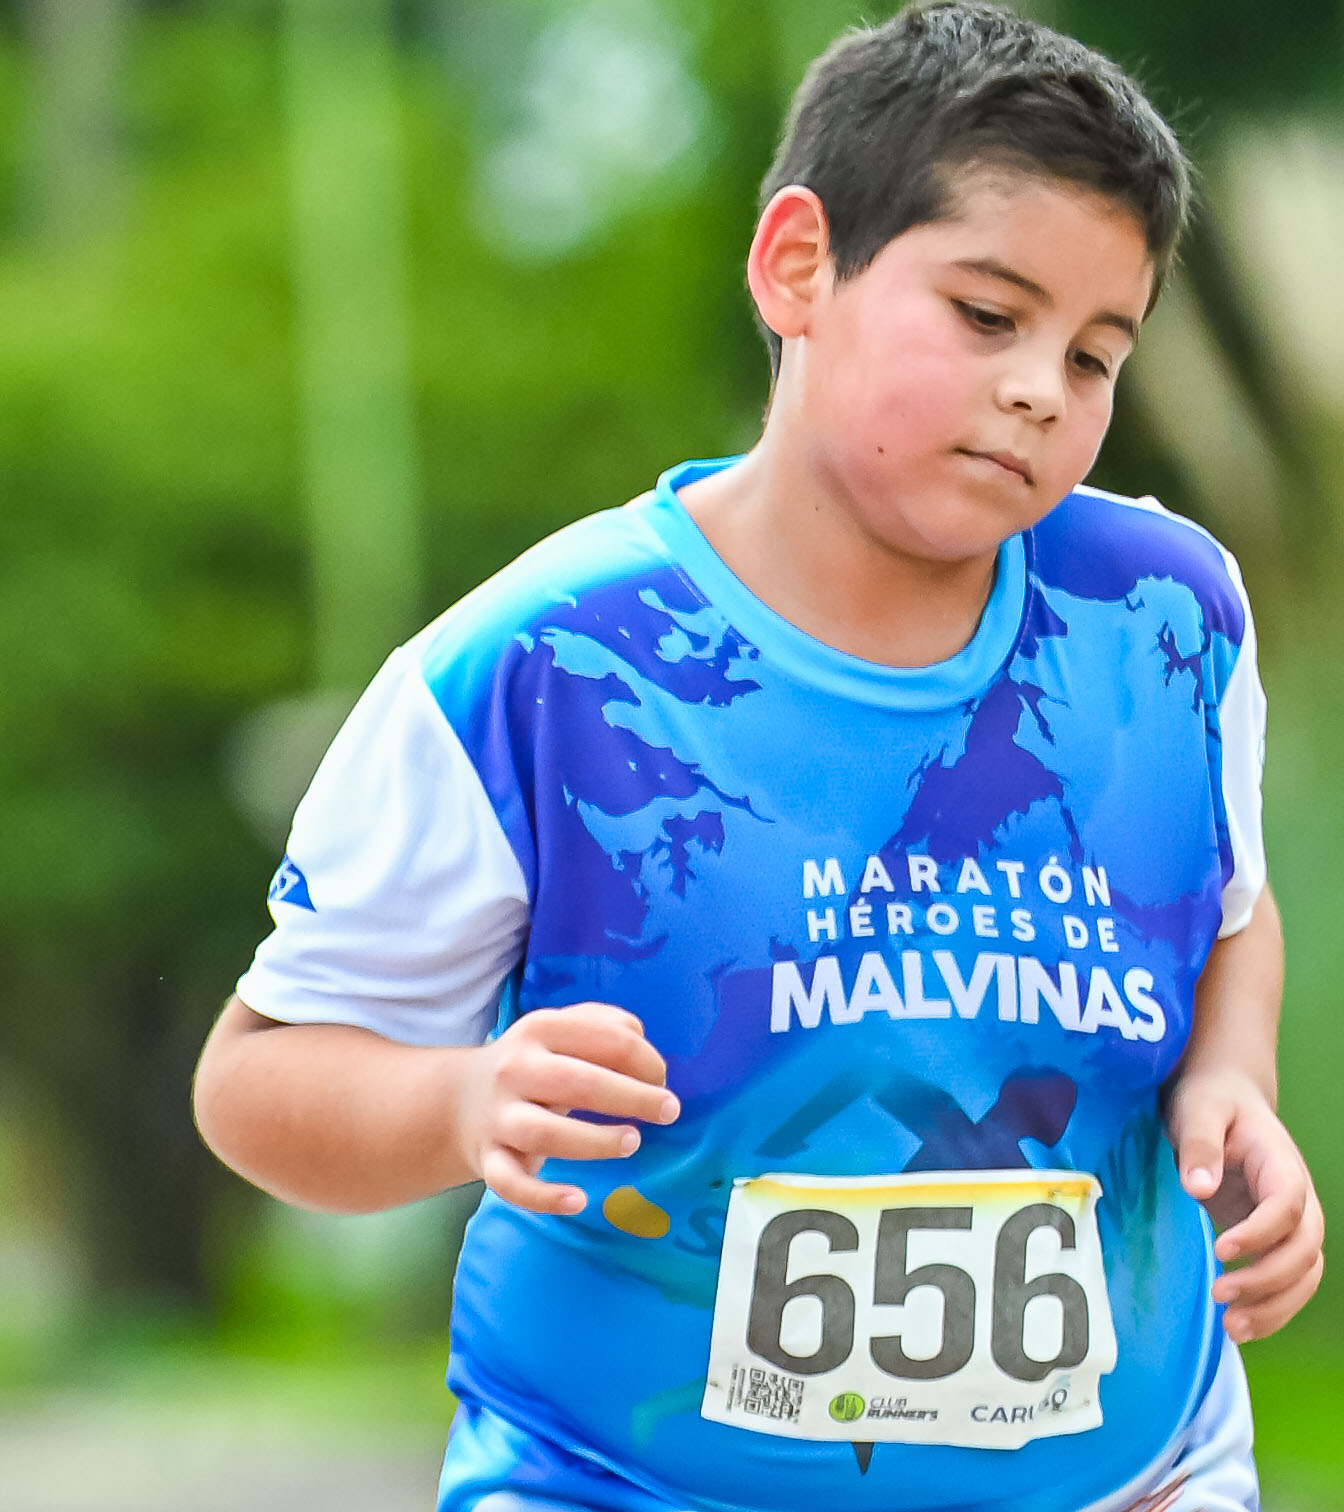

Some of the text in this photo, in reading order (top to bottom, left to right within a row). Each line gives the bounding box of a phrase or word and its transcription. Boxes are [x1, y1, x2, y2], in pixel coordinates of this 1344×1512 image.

[802, 854, 1112, 907] MARATÓN
[806, 896, 1120, 953] HÉROES DE
[770, 950, 1167, 1043] MALVINAS
[746, 1203, 1090, 1382] 656
